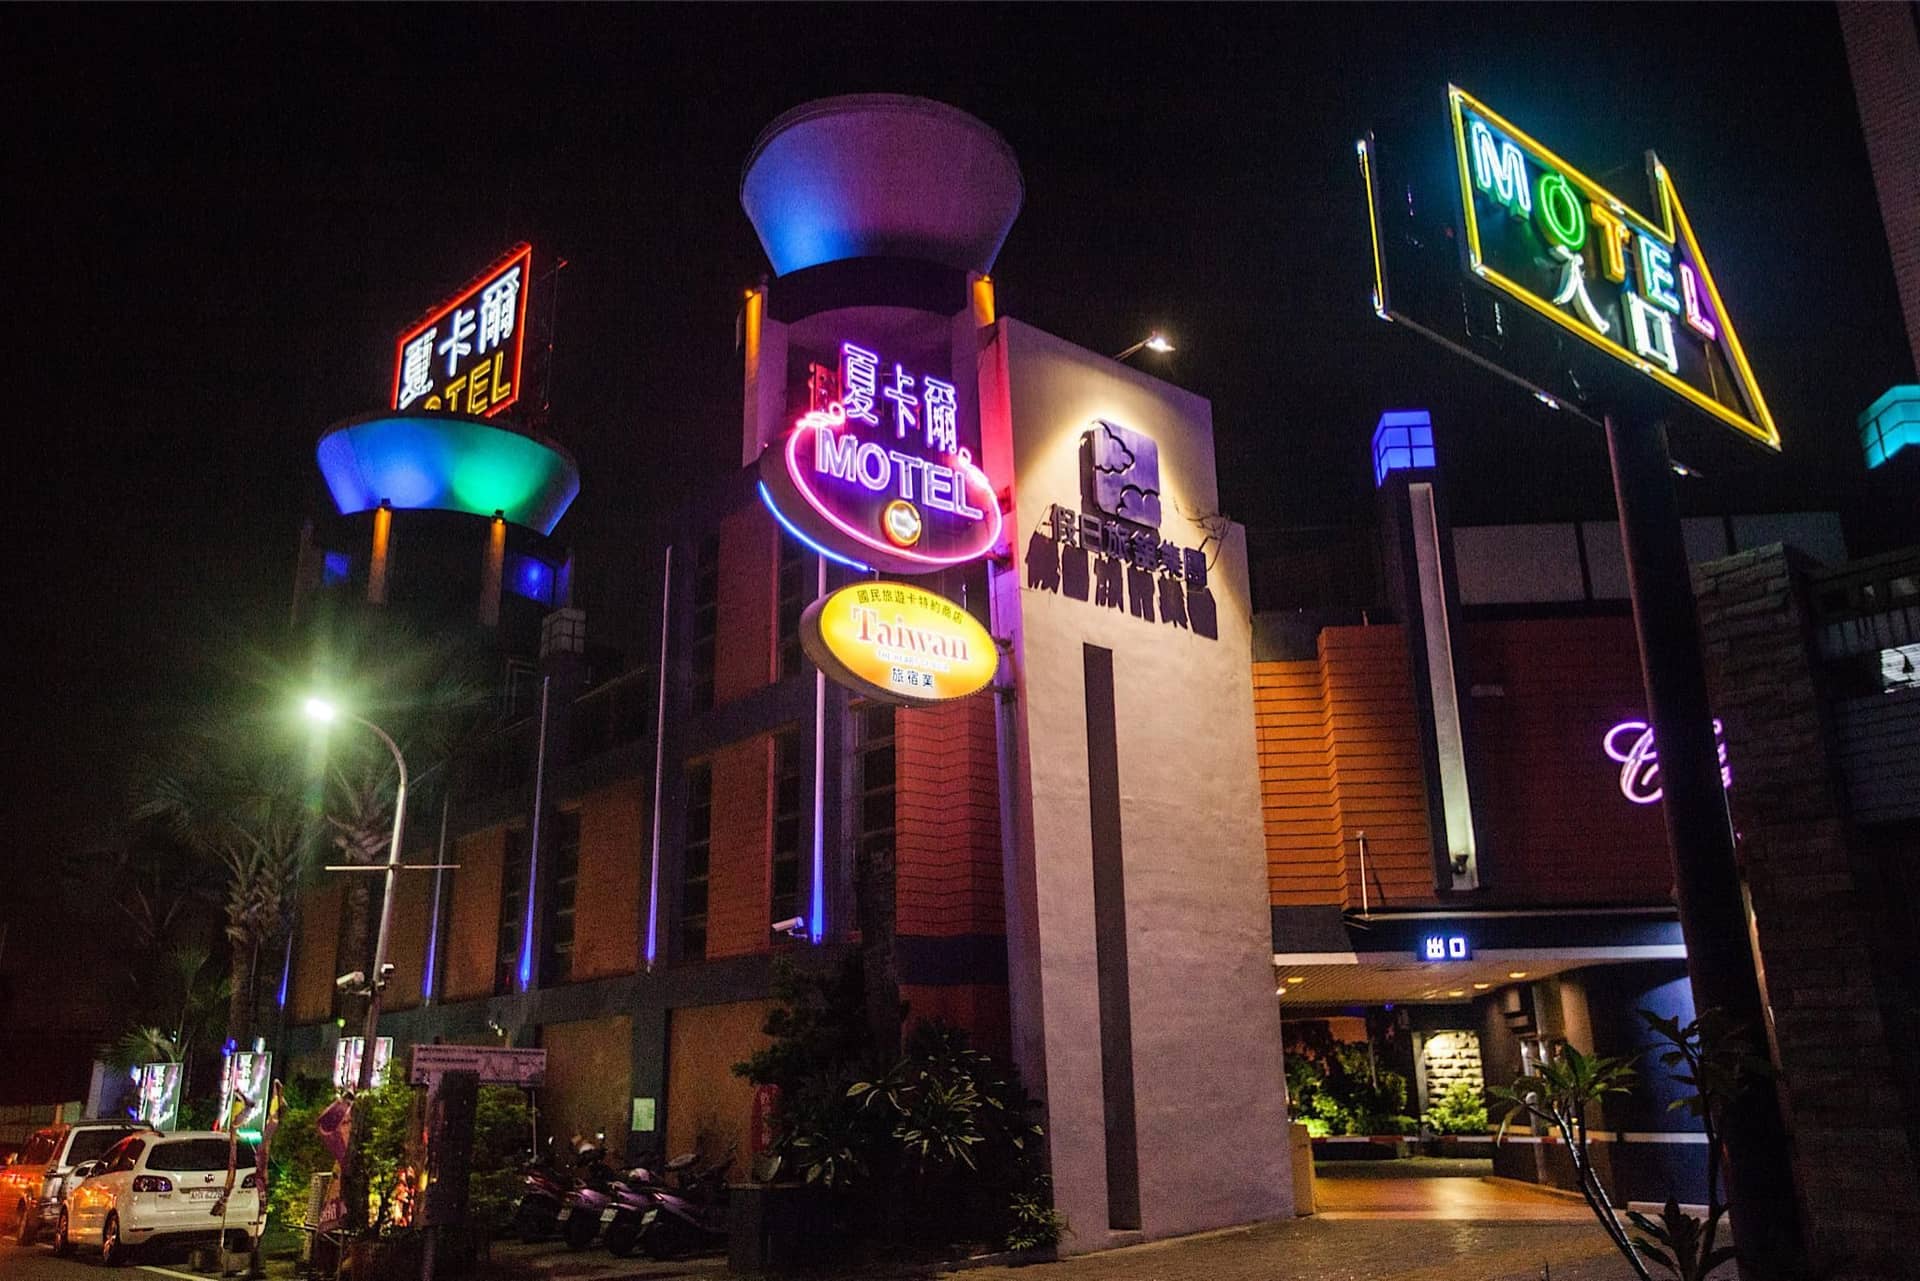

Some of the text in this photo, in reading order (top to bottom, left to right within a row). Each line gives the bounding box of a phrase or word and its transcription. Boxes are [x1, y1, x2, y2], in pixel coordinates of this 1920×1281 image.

[1471, 121, 1717, 342] MOTEL
[399, 267, 521, 410] 夏卡爾
[1550, 245, 1679, 375] 入口
[843, 341, 958, 454] 夏卡爾
[814, 426, 984, 520] MOTEL
[854, 608, 968, 660] Taiwan
[857, 588, 963, 625] 國民旅遊卡特約商店
[892, 667, 934, 689] 旅宿業
[1427, 937, 1466, 958] 出口
